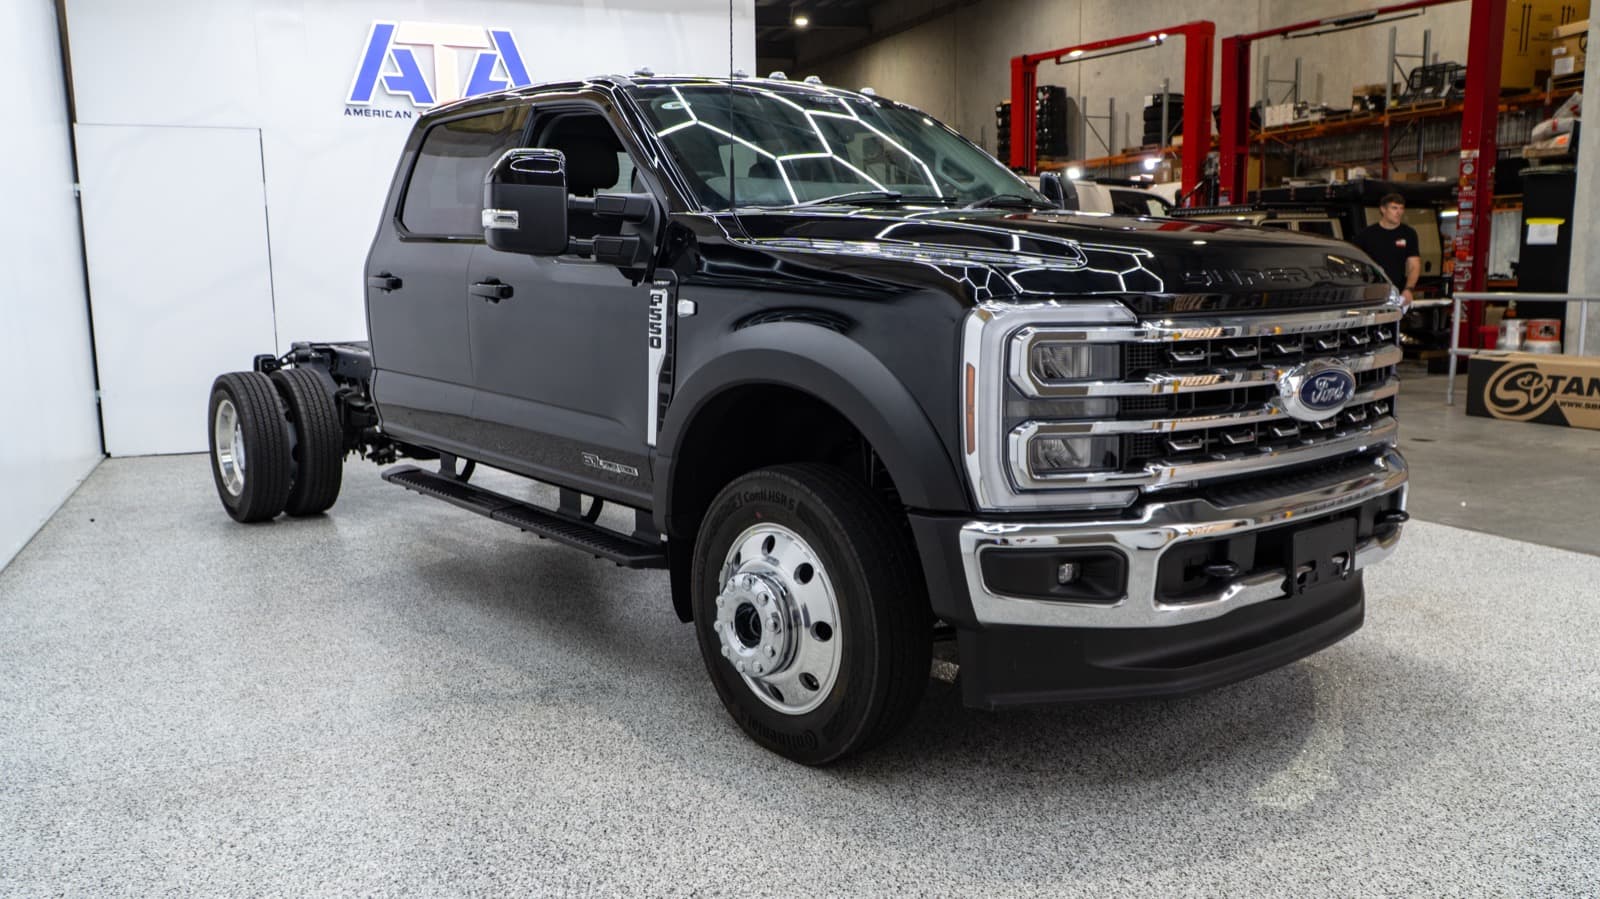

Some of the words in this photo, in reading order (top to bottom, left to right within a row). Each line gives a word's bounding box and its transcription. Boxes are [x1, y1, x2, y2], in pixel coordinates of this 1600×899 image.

[346, 20, 532, 106] ATA
[343, 107, 412, 119] AMERICAN
[649, 293, 664, 349] F550
[1311, 375, 1346, 404] Ford
